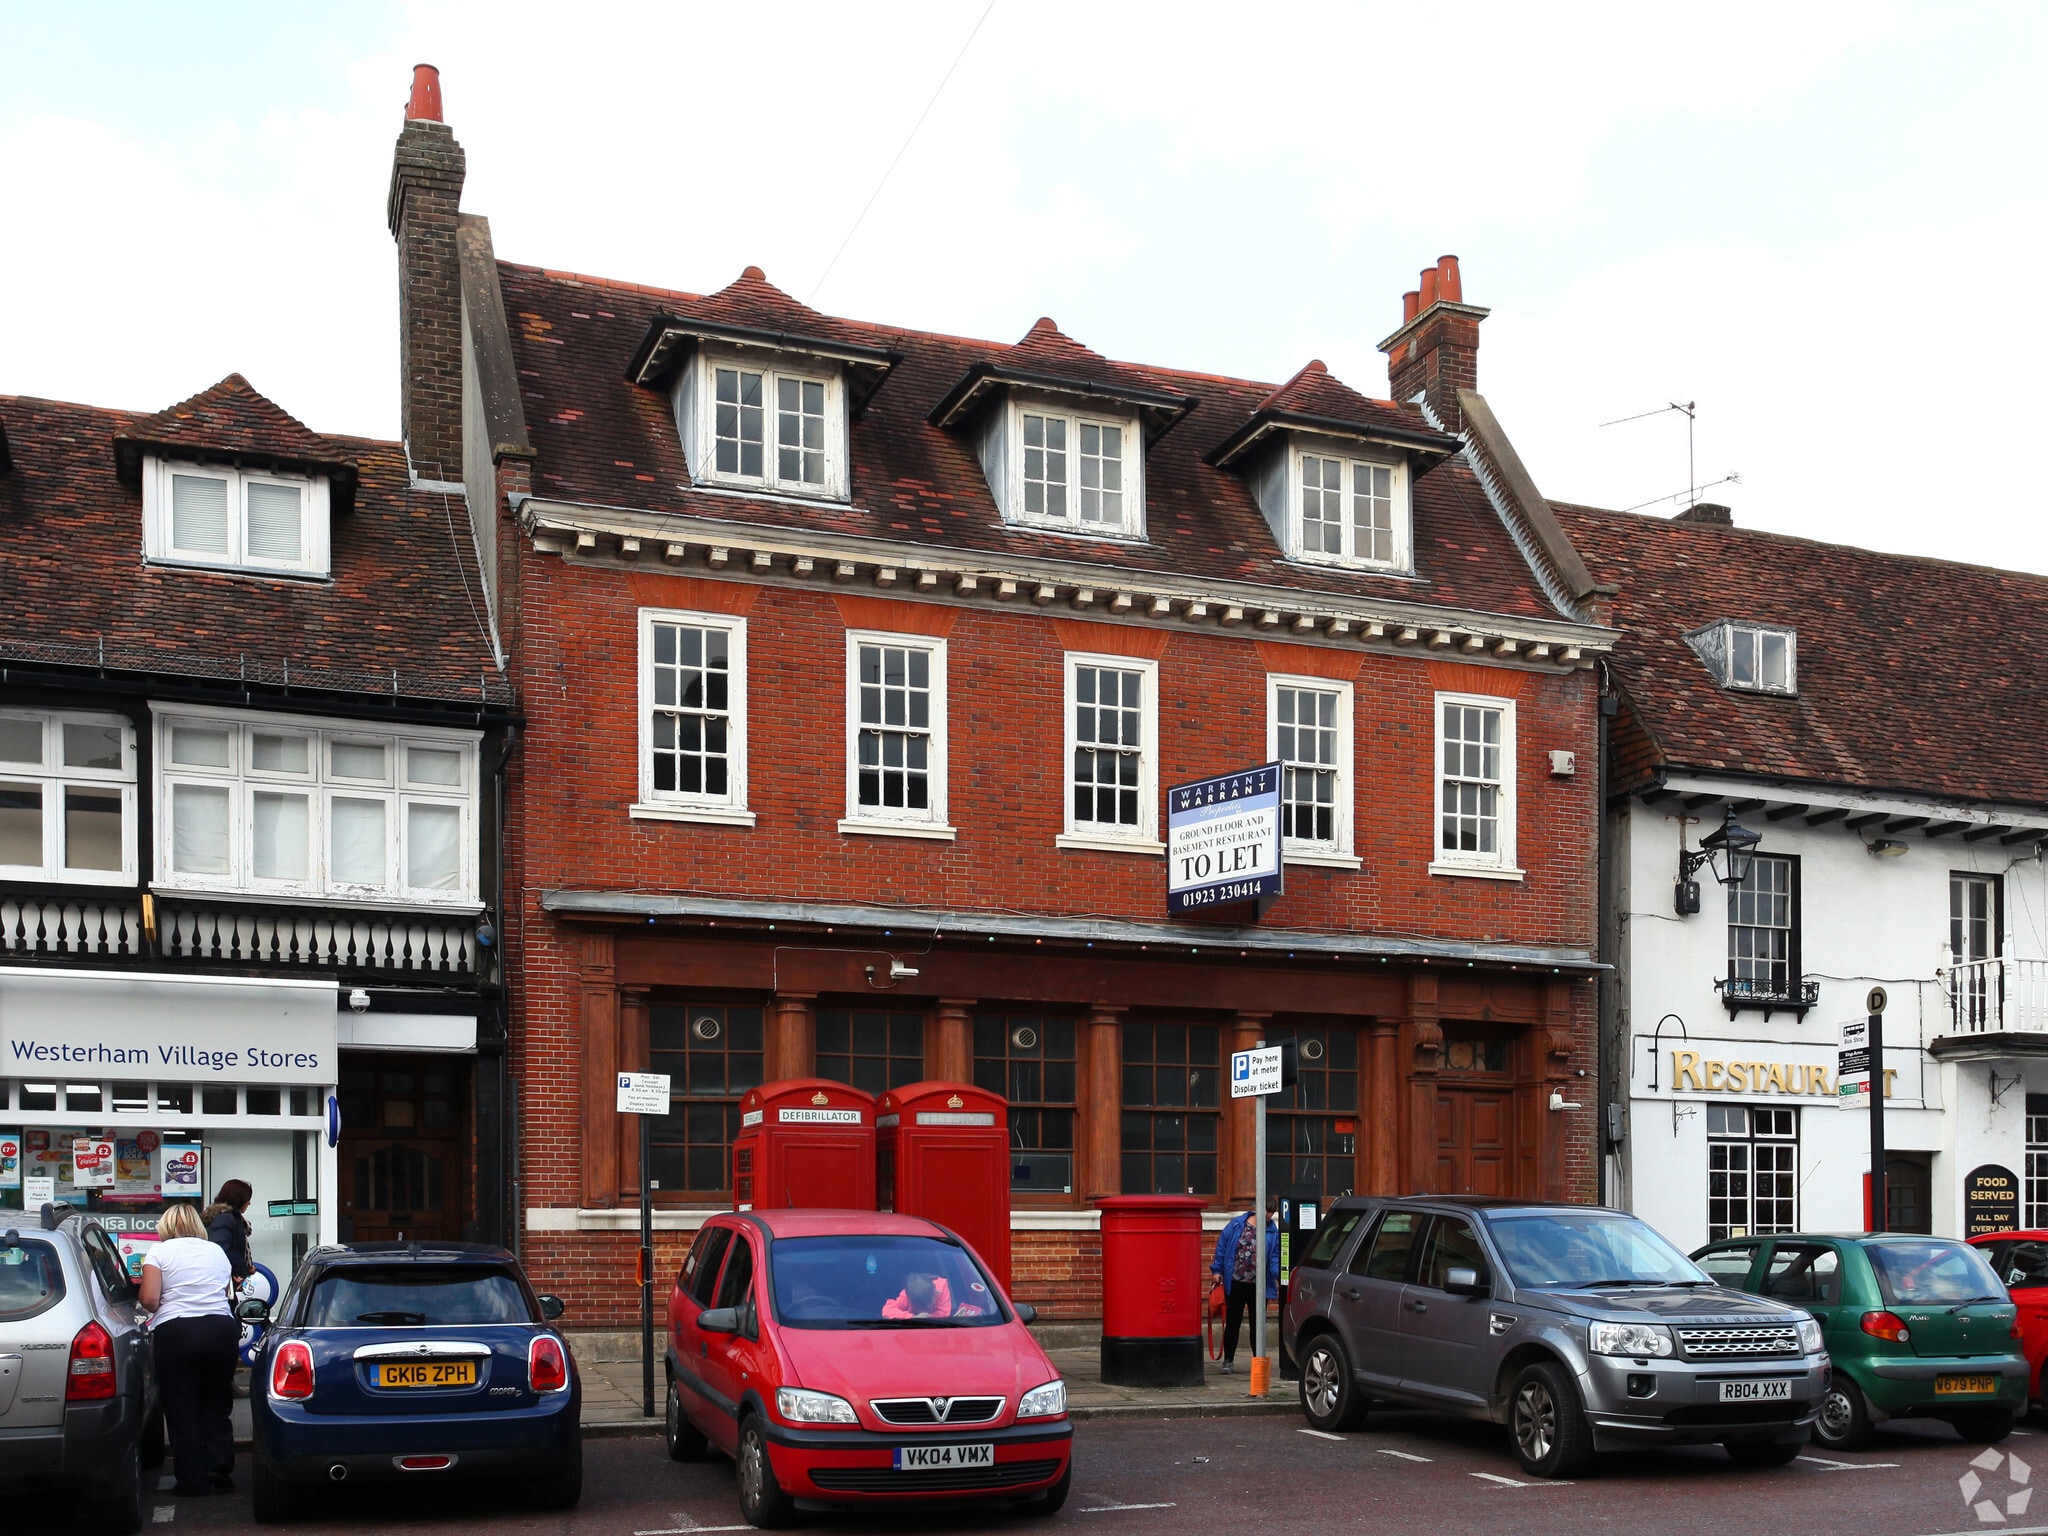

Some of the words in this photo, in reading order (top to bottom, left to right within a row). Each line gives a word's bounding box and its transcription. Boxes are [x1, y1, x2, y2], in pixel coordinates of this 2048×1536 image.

[1181, 773, 1266, 799] WARRANT
[1181, 783, 1266, 809] WARRANT
[1200, 801, 1242, 817] Properties
[1180, 826, 1213, 841] GROUND
[1214, 820, 1243, 834] FLOOR
[1245, 815, 1264, 828] AND
[1172, 838, 1214, 855] BASEMENT
[1216, 827, 1273, 847] RESTAURANT
[1181, 854, 1211, 881] TO
[1217, 843, 1263, 875] LET
[1183, 888, 1216, 906] 01923
[1219, 880, 1262, 900] 230414
[1872, 992, 1884, 1010] D
[1853, 1036, 1865, 1044] Stop
[11, 1040, 149, 1064] Westerham
[158, 1045, 239, 1070] Village
[247, 1048, 319, 1068] Stores
[1252, 1055, 1263, 1065] Pay
[1265, 1054, 1278, 1063] here
[1252, 1068, 1259, 1076] at
[1261, 1065, 1279, 1075] meter
[1671, 1050, 1898, 1098] RESTAURT
[1234, 1084, 1257, 1094] Display
[1259, 1081, 1279, 1091] ticket
[782, 1110, 858, 1121] DEFIBRILLATOR
[98, 1147, 109, 1156] £2
[1977, 1178, 2008, 1187] FOOD
[1970, 1191, 2015, 1200] SERVED
[387, 1367, 427, 1383] GK16
[433, 1366, 468, 1382] ZPH
[1725, 1382, 1760, 1398] RB04
[1762, 1381, 1788, 1397] XXX
[1936, 1378, 1967, 1391] W679
[1969, 1377, 1993, 1390] PNP
[906, 1448, 952, 1466] VK04
[957, 1446, 990, 1463] VMX
